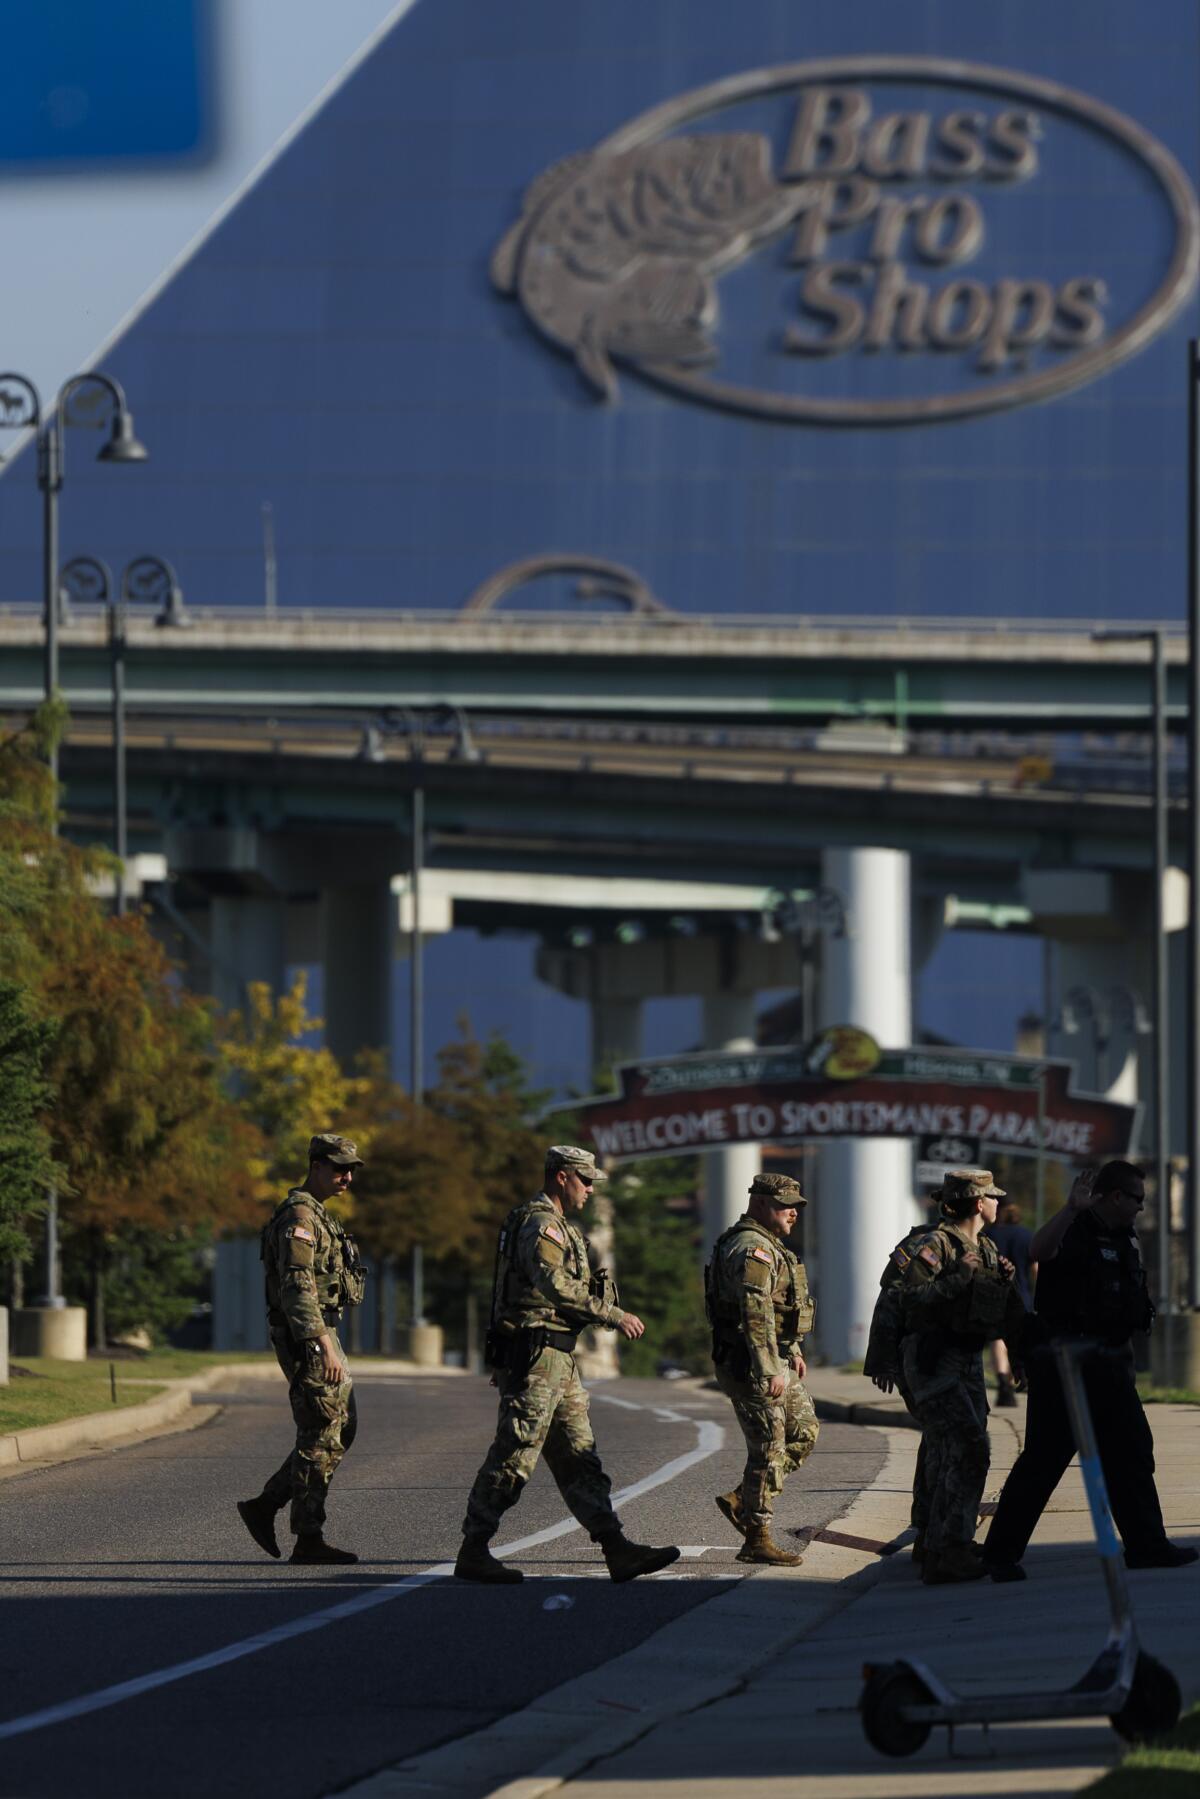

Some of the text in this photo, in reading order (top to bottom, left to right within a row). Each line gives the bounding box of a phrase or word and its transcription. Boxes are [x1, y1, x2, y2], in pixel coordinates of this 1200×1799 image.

[784, 86, 1043, 180] Bass
[790, 178, 984, 267] Pro
[783, 262, 1107, 373] Shops
[591, 1108, 728, 1151] WELCOME
[731, 1103, 776, 1136] TO
[780, 1099, 966, 1135] SPORTSMAN'S
